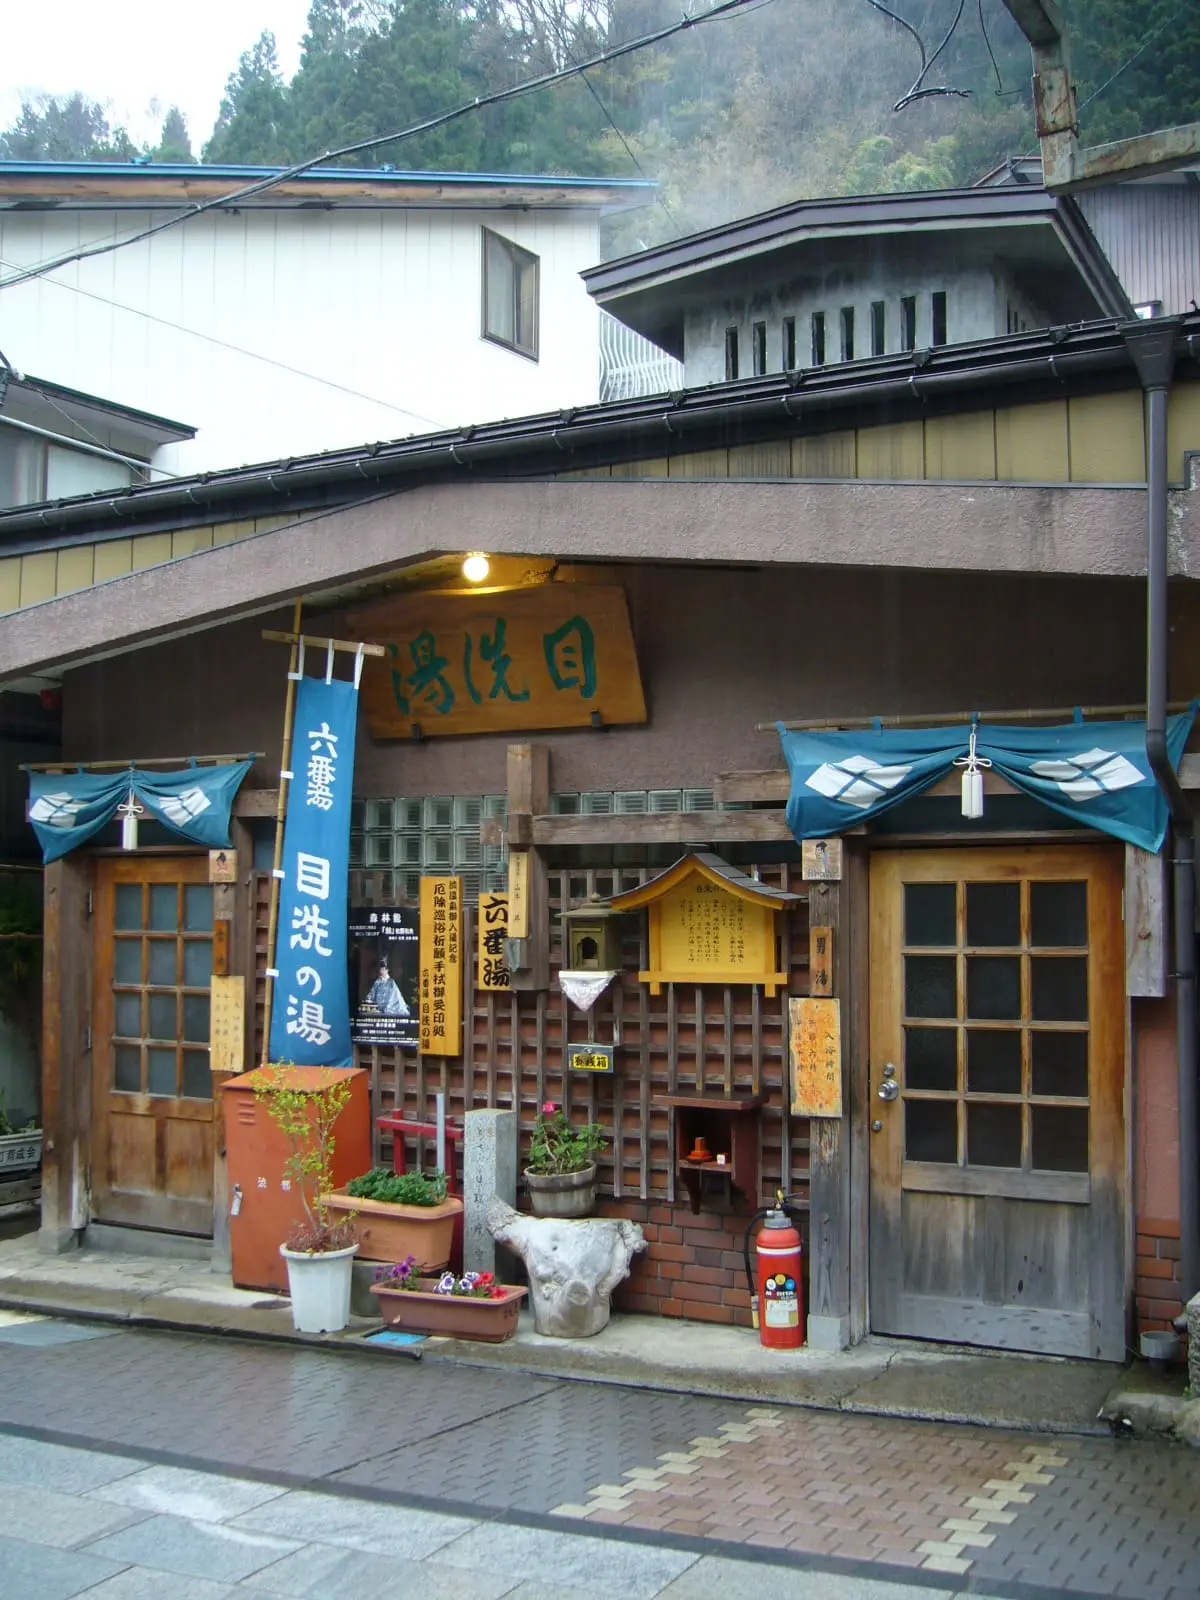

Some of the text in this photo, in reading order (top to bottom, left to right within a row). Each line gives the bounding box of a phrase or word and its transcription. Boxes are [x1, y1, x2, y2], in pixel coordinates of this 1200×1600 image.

[286, 721, 339, 1046] 六番湯 目洗の湯
[482, 895, 510, 987] 六番湯
